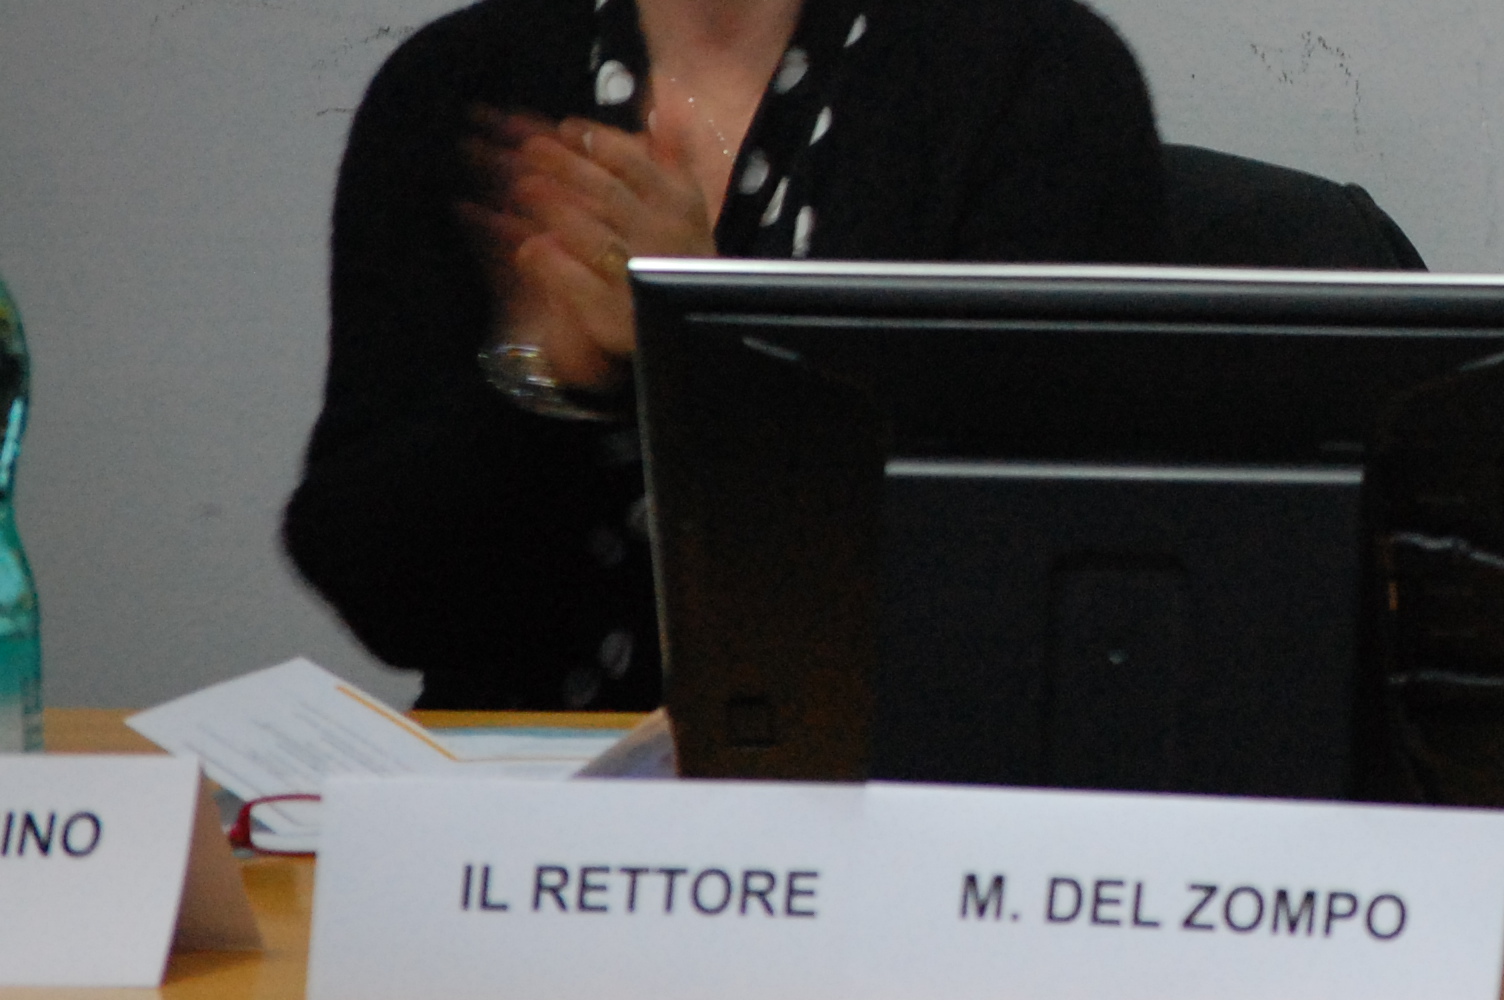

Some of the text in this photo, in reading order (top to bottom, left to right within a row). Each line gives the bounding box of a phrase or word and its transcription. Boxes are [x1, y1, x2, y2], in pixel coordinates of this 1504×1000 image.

[460, 863, 1408, 942] IL RETTORE M. DEL ZOMPO
